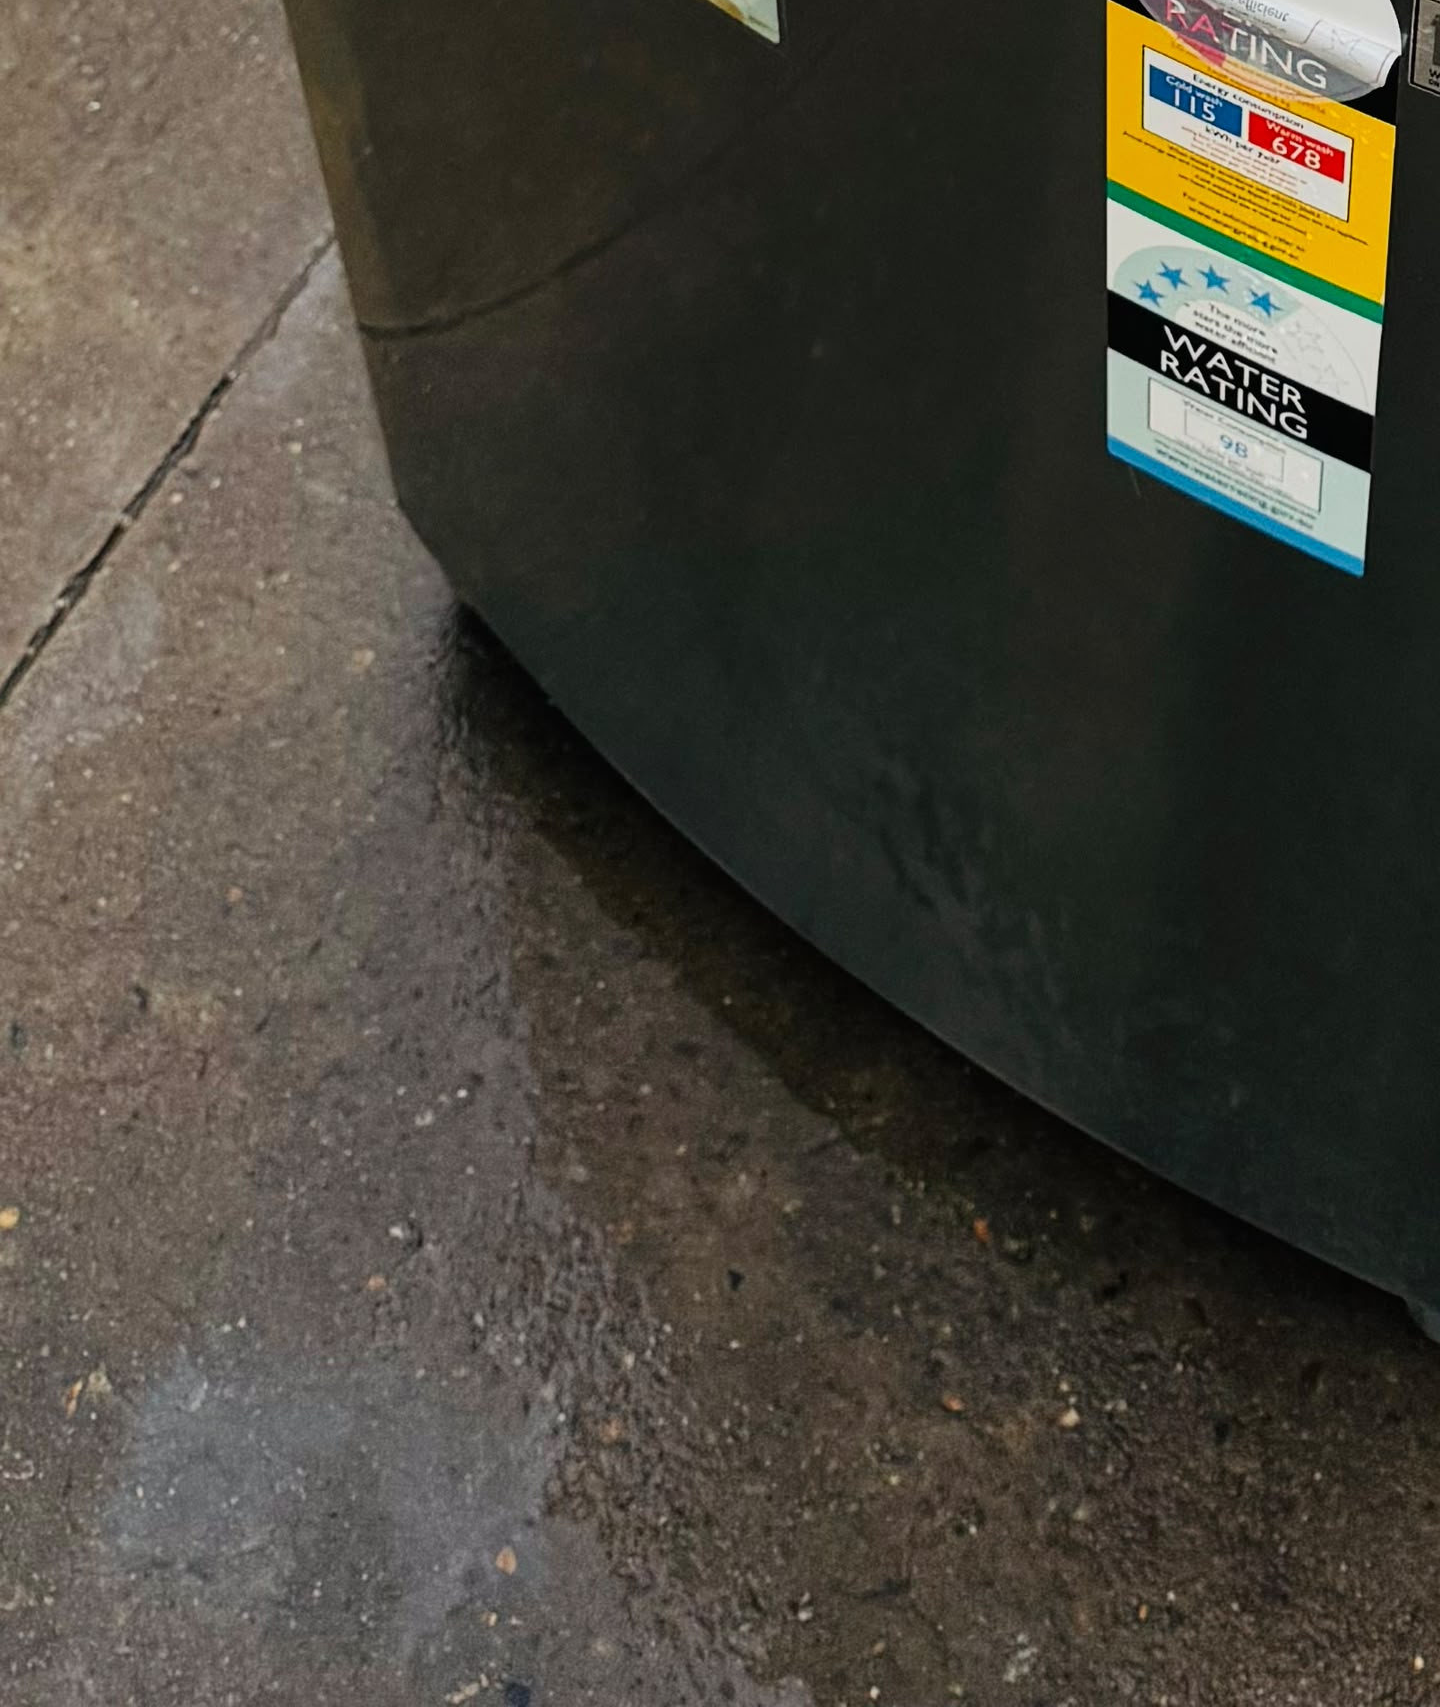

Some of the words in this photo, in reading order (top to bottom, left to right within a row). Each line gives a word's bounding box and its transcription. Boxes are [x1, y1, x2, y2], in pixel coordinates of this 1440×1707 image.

[1165, 74, 1193, 95] Cold
[1193, 86, 1223, 108] wash
[1173, 88, 1217, 123] 115
[1233, 92, 1304, 131] consumption
[1265, 118, 1303, 144] Warm
[1305, 140, 1335, 158] wash
[1271, 136, 1322, 171] 678
[1193, 310, 1221, 328] stars
[1223, 323, 1243, 338] the
[1247, 336, 1278, 355] more
[1209, 303, 1231, 320] The
[1234, 317, 1266, 337] more
[1163, 324, 1306, 415] WATER
[1160, 349, 1308, 440] RATING
[1219, 434, 1248, 460] 98
